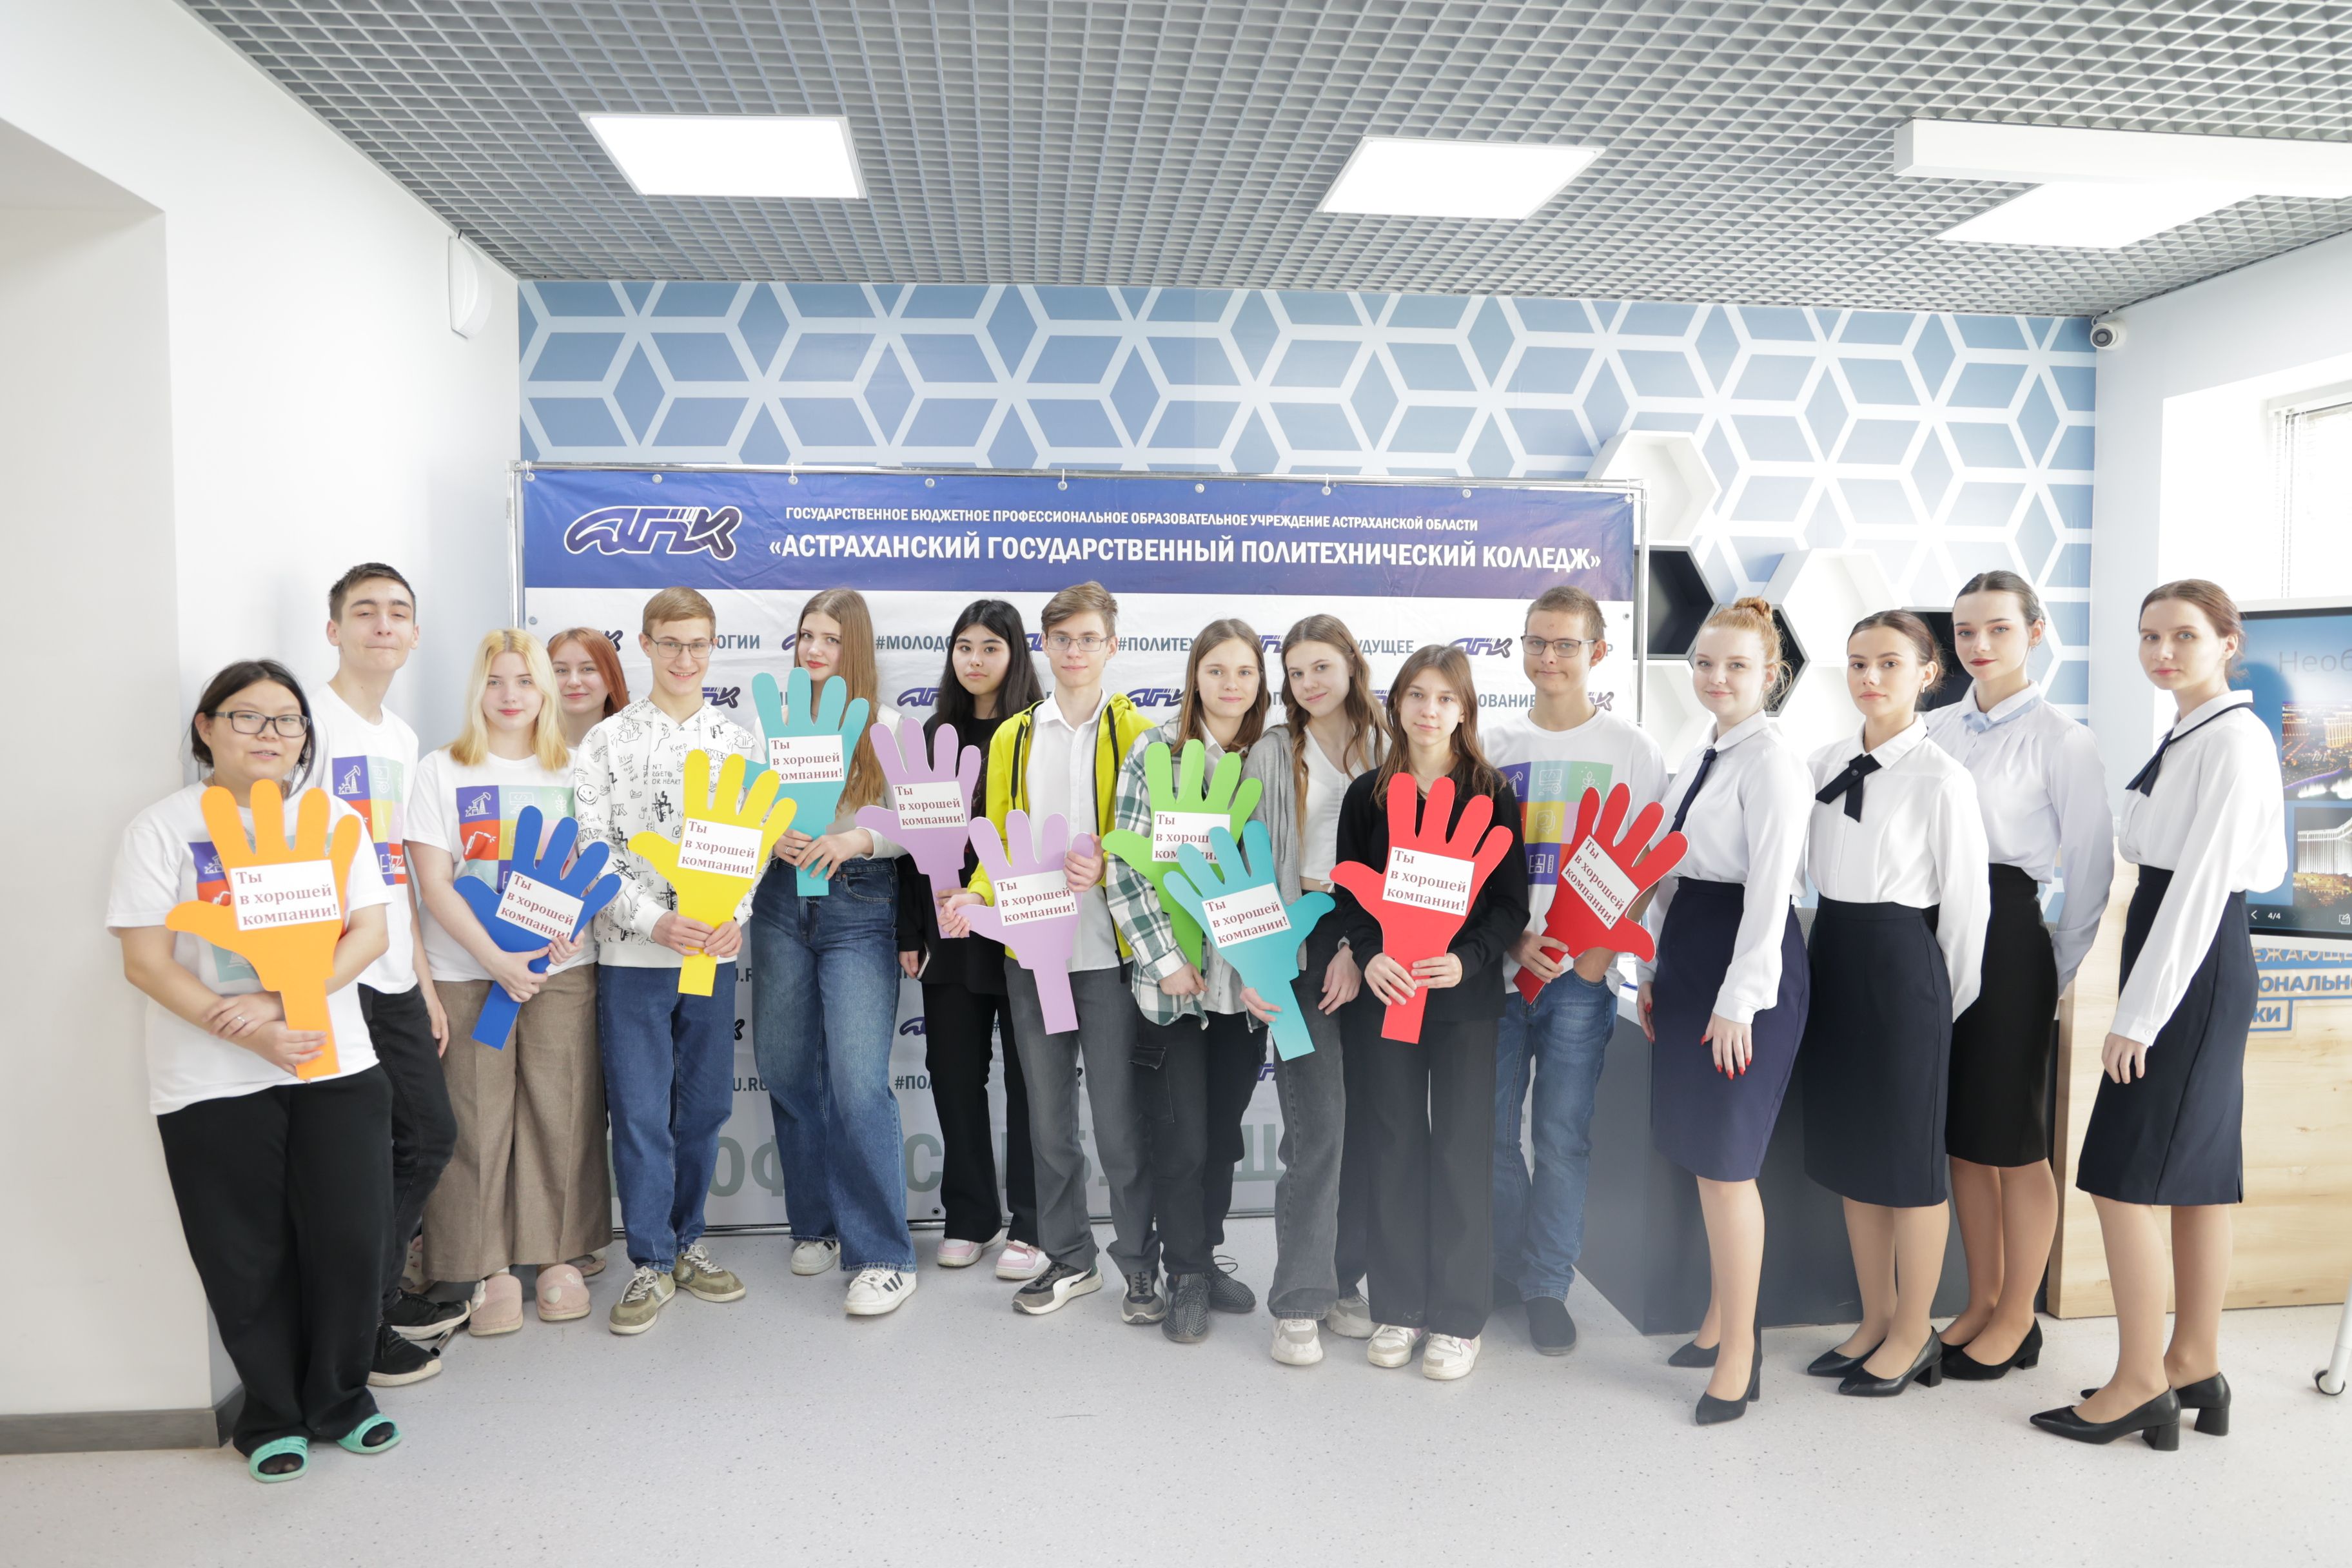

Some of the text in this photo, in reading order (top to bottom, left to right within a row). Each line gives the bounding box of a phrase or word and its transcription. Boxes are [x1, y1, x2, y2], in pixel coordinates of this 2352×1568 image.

[785, 507, 1478, 531] ГОСУДАРСТВЕННОЕ БЮДЖЕТНОЕ ПРОФЕССИОНАЛЬНОЕ ОБРАЗОВАТЕЛЬНОЕ УЧРЕЖДЕНИЕ АСТРАХАНСКОЙ ОБЛАСТИ
[769, 531, 1601, 573] «АСТРАХАНСКИЙ ГОСУДАРСТВЕННЫЙ ПОЛИТЕХНИЧЕСКИЙ КОЛЛЕДЖ»
[771, 740, 790, 750] Ты
[783, 752, 839, 767] хорошей
[779, 768, 843, 781] омпании!
[896, 786, 913, 796] Ты
[908, 798, 960, 812] хорошей
[689, 821, 707, 834] Ты
[901, 813, 965, 826] компании!
[1156, 814, 1175, 825] Ты
[1166, 834, 1209, 844] хорош
[695, 841, 755, 858] хорошей
[1395, 850, 1415, 864] Ты
[1585, 839, 1599, 859] Ты
[681, 856, 754, 875] компании!
[236, 872, 262, 884] Ты
[514, 874, 531, 890] Ты
[997, 881, 1017, 892] Ты
[1391, 870, 1467, 893] в хорошей
[1574, 855, 1625, 910] в хорошей
[240, 884, 331, 905] в хорошей
[1012, 887, 1071, 906] хорошей
[1387, 888, 1465, 911] компании!
[1565, 868, 1616, 925] компании!
[242, 904, 337, 925] компании!
[507, 892, 574, 926] в хорошей
[1004, 902, 1075, 923] компании!
[1206, 901, 1226, 912] Ты
[1222, 901, 1280, 925] хорошей
[1218, 916, 1288, 944] компании!
[2259, 975, 2352, 992] ОНАЛЬН
